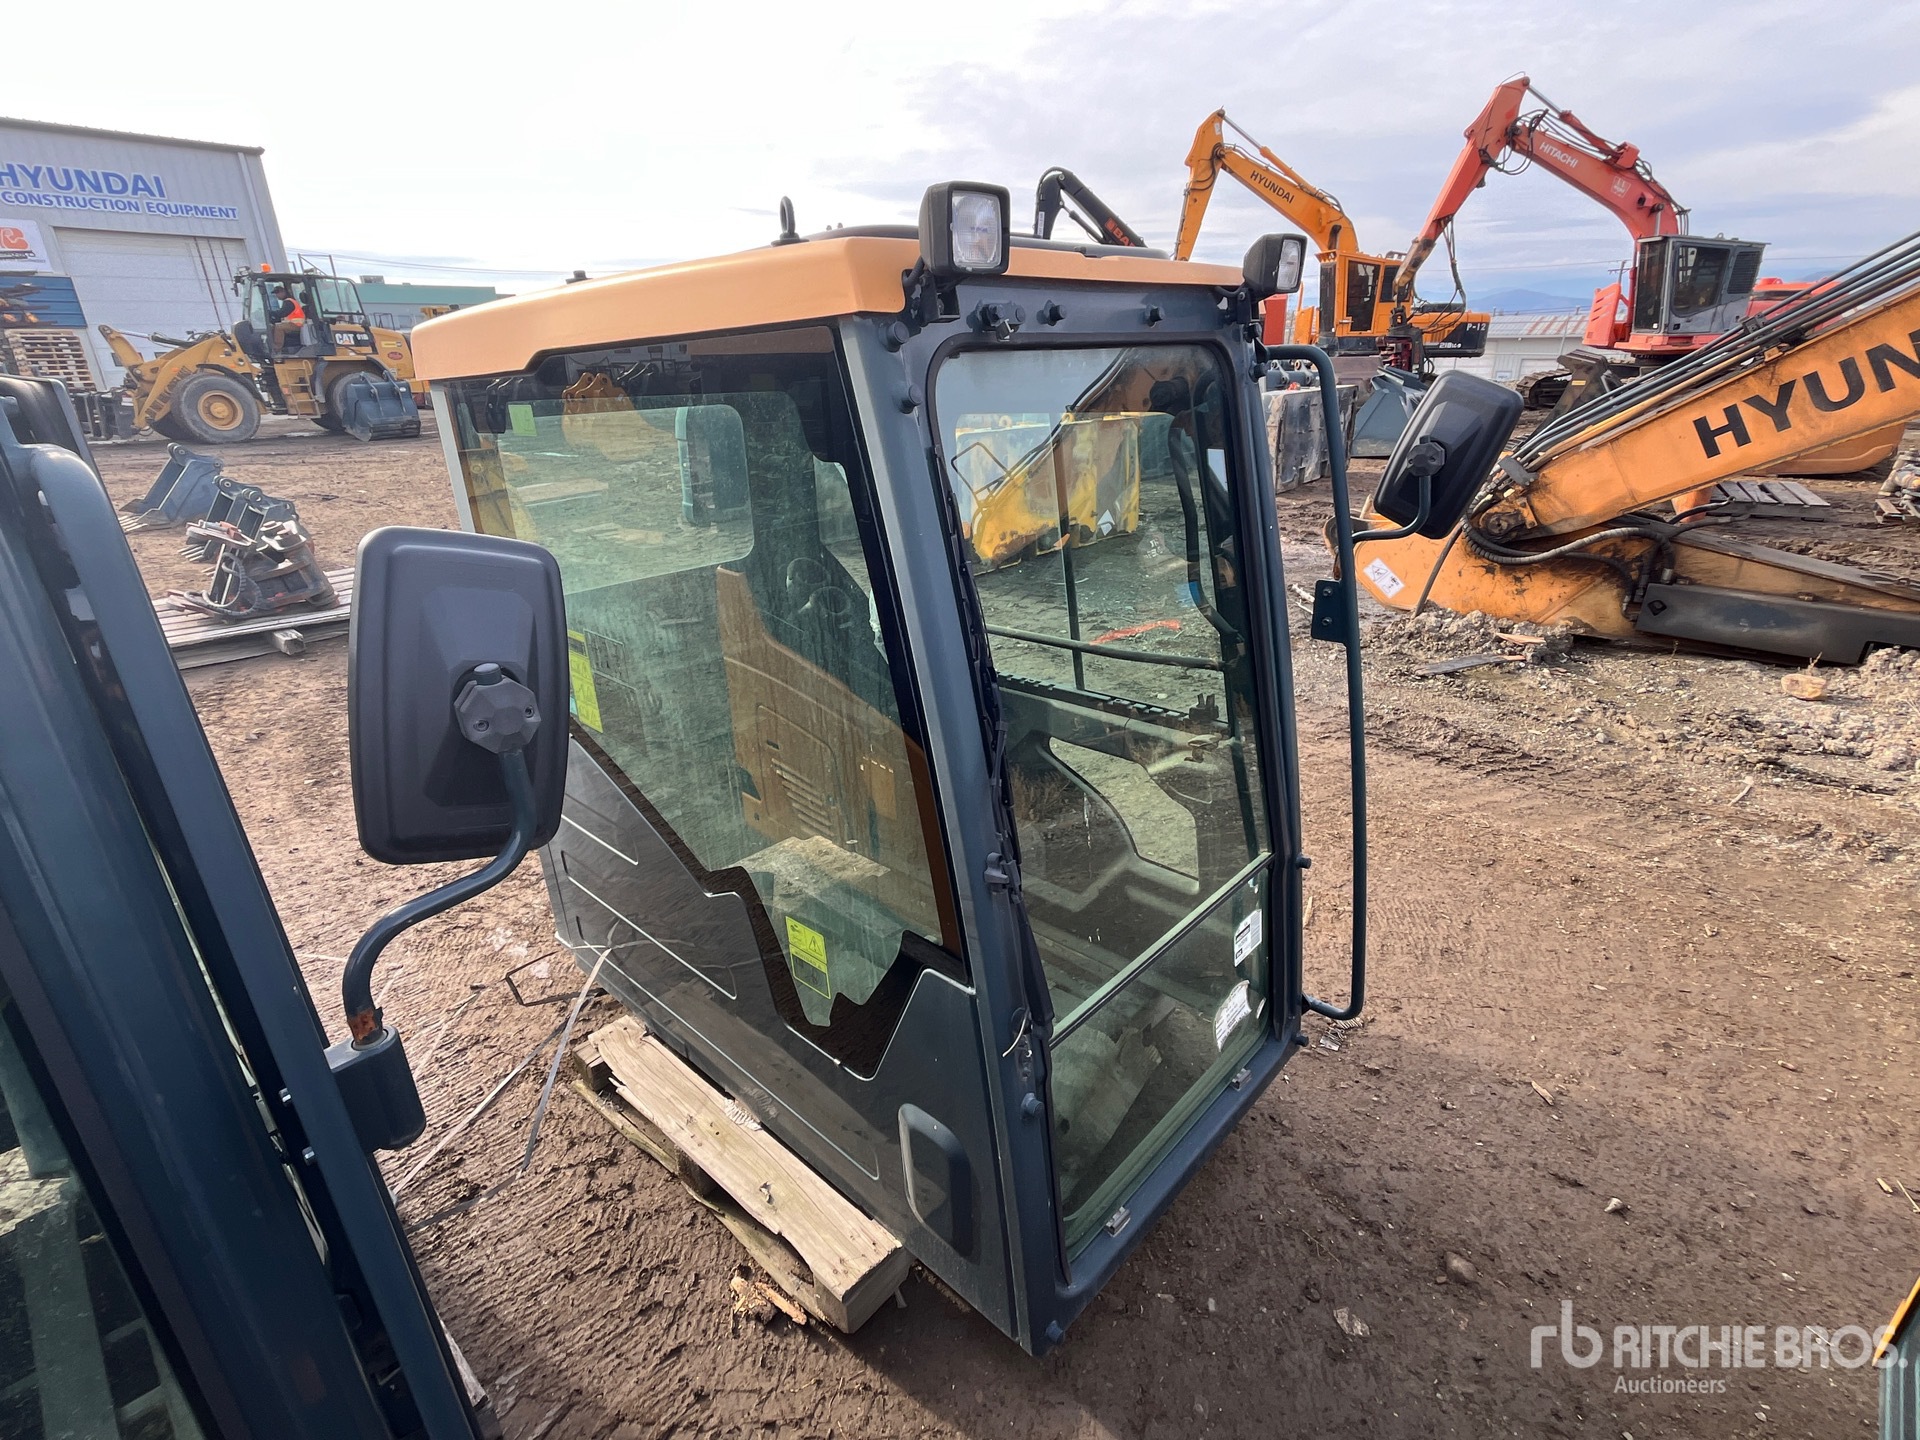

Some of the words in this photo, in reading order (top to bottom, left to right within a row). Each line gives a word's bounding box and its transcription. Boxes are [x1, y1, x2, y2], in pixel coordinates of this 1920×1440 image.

[1540, 142, 1579, 168] HITACHI
[0, 163, 166, 198] HYUNDAI
[1249, 170, 1294, 204] HYUNDAI
[2, 191, 140, 212] CONSTRUCTION
[147, 202, 238, 219] EQUIPMENT
[335, 333, 355, 345] CAT
[1466, 323, 1487, 331] P-12
